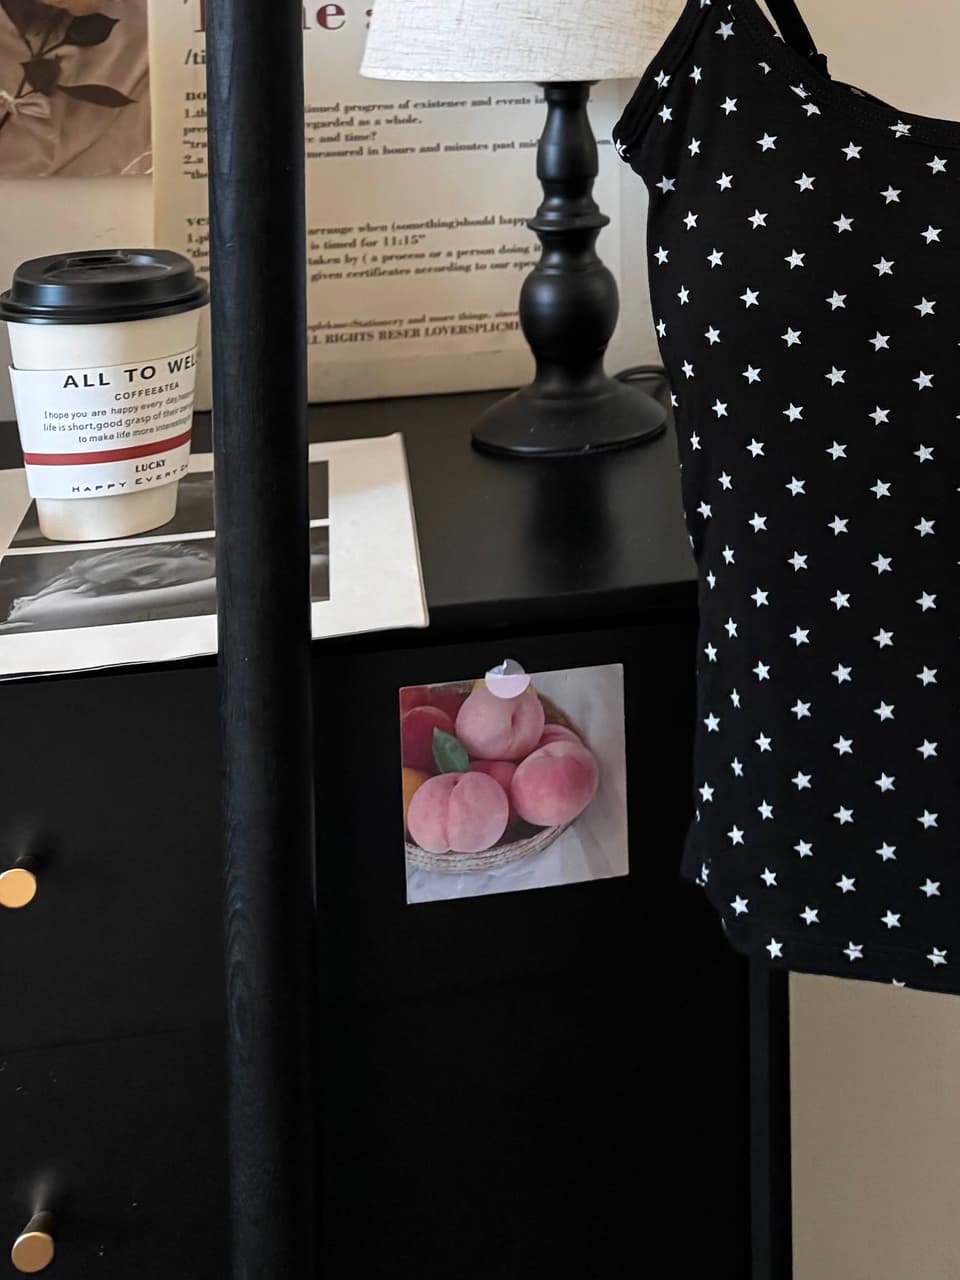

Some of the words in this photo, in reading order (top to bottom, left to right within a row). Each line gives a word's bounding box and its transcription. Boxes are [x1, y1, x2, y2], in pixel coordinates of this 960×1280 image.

[184, 49, 207, 65] /ti
[184, 91, 207, 101] no
[398, 99, 411, 109] of
[471, 96, 492, 107] and
[495, 96, 531, 106] events
[319, 132, 341, 143] and
[367, 147, 379, 156] in
[419, 142, 441, 153] and
[444, 142, 489, 152] minutes
[492, 140, 516, 152] past
[519, 138, 541, 149] mid
[358, 222, 388, 233] when
[499, 214, 529, 227] happ
[323, 237, 357, 250] timed
[360, 237, 379, 248] for
[344, 252, 358, 267] by
[428, 250, 443, 259] or
[446, 250, 453, 258] a
[456, 247, 496, 260] person
[474, 261, 487, 270] to
[325, 331, 375, 344] RIGHTS
[63, 372, 111, 389] ALL
[123, 365, 157, 383] TO
[114, 381, 180, 401] COFFEE&TEA
[49, 411, 69, 420] hope
[70, 411, 88, 420] you
[91, 409, 107, 418] are
[110, 406, 139, 416] happy
[140, 400, 164, 410] every
[43, 423, 57, 432] life
[59, 423, 66, 431] is
[125, 414, 152, 428] grasp
[153, 410, 162, 420] of
[78, 435, 88, 443] to
[89, 432, 115, 442] make
[116, 430, 132, 439] life
[132, 427, 154, 437] more
[135, 459, 166, 473] LUCKY
[72, 481, 127, 493] HAPPY
[135, 468, 178, 485] EVERY
